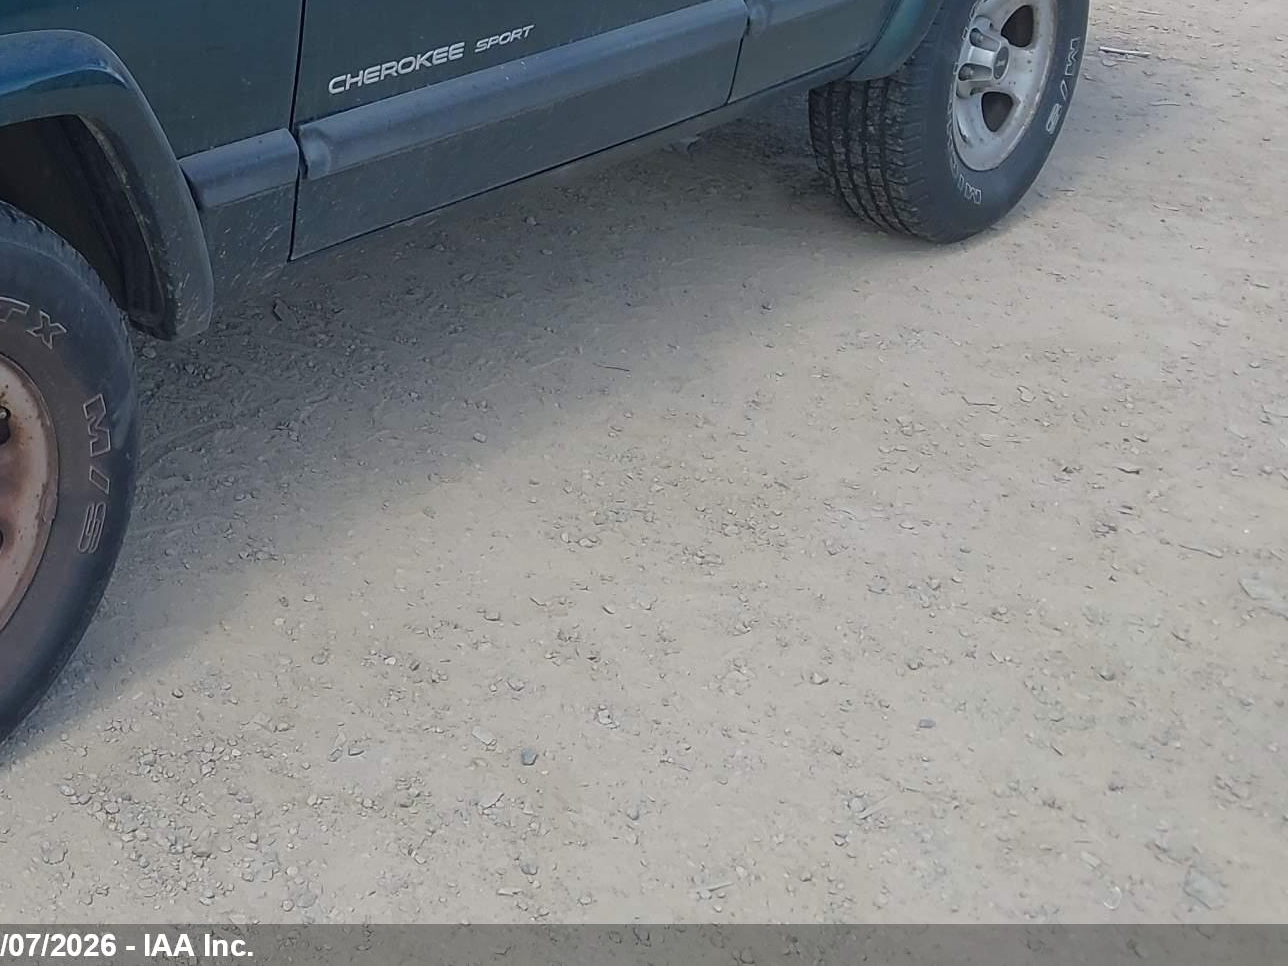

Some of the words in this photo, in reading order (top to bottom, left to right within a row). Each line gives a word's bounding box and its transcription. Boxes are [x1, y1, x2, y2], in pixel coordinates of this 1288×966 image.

[328, 41, 465, 95] CHEROKEE
[474, 24, 535, 53] SPORT
[78, 393, 111, 554] M/S
